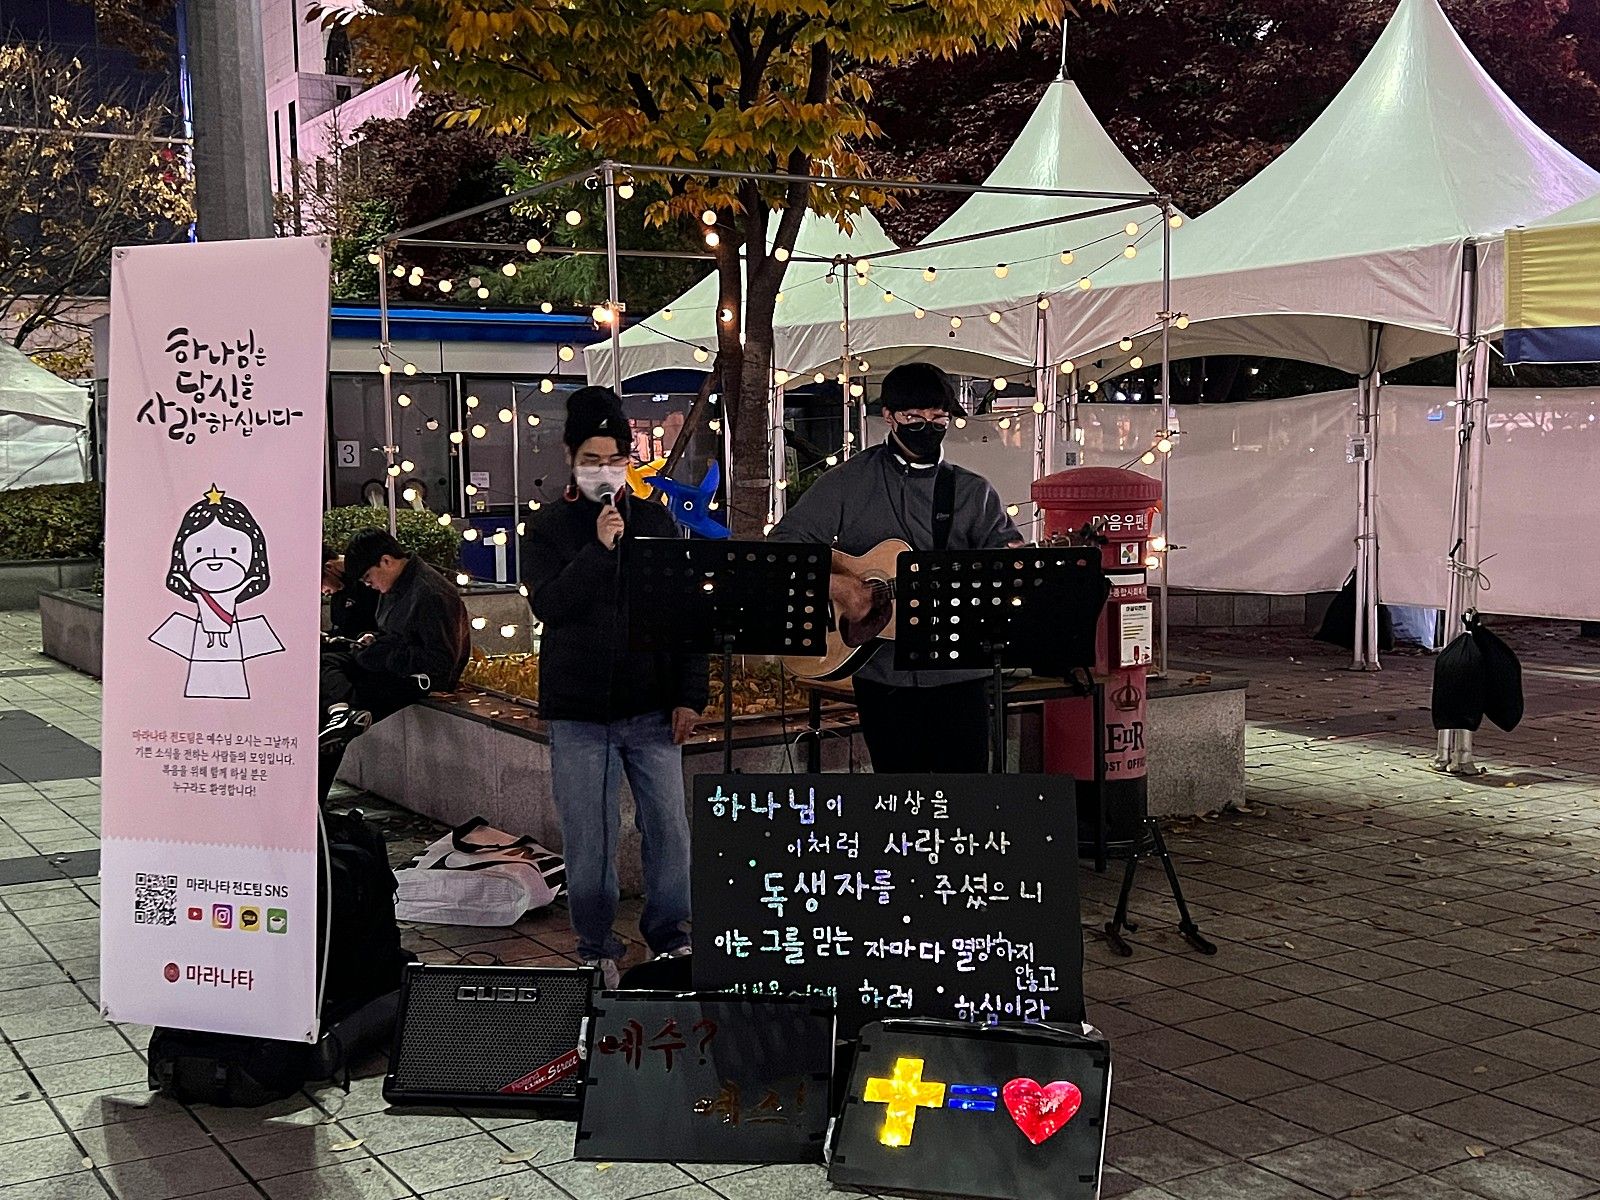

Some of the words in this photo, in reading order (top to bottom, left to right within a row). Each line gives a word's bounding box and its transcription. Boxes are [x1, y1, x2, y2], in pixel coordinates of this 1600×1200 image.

[165, 327, 267, 368] 하나님은
[176, 370, 254, 408] 당신을
[136, 391, 304, 444] 사랑하십니다
[342, 444, 355, 465] 3
[206, 732, 232, 746] 예수님
[235, 734, 261, 747] 오시는
[264, 735, 298, 748] 그날까지
[135, 746, 152, 758] 기쁜
[155, 747, 181, 760] 소식을
[183, 748, 208, 761] 전하는
[211, 750, 246, 763] 사람들의
[249, 751, 295, 765] 모임입니다.
[1103, 760, 1121, 771] OST
[173, 781, 207, 793] 누구라도
[230, 767, 247, 780] 하실
[250, 768, 268, 781] 분은
[707, 786, 843, 824] 하나님이
[874, 789, 949, 820] 세상을
[787, 831, 859, 858] 이처럼
[884, 828, 1011, 864] 사랑하사
[186, 878, 230, 893] 마라나타
[232, 881, 262, 897] 전도팀
[264, 884, 289, 898] SNS
[760, 869, 896, 917] 독생자를
[933, 872, 1042, 910] 주셨으니
[714, 929, 753, 958] 이는
[760, 926, 805, 965] 그를
[812, 926, 853, 957] 믿는
[863, 937, 946, 963] 자마다
[951, 931, 1034, 972] 멸망하지
[186, 965, 254, 991] 마라나타
[1015, 963, 1059, 992] 않고
[858, 978, 913, 1009] 하려
[954, 993, 1051, 1026] 하심이라
[598, 1017, 718, 1073] 예수?
[547, 1055, 578, 1080] Street
